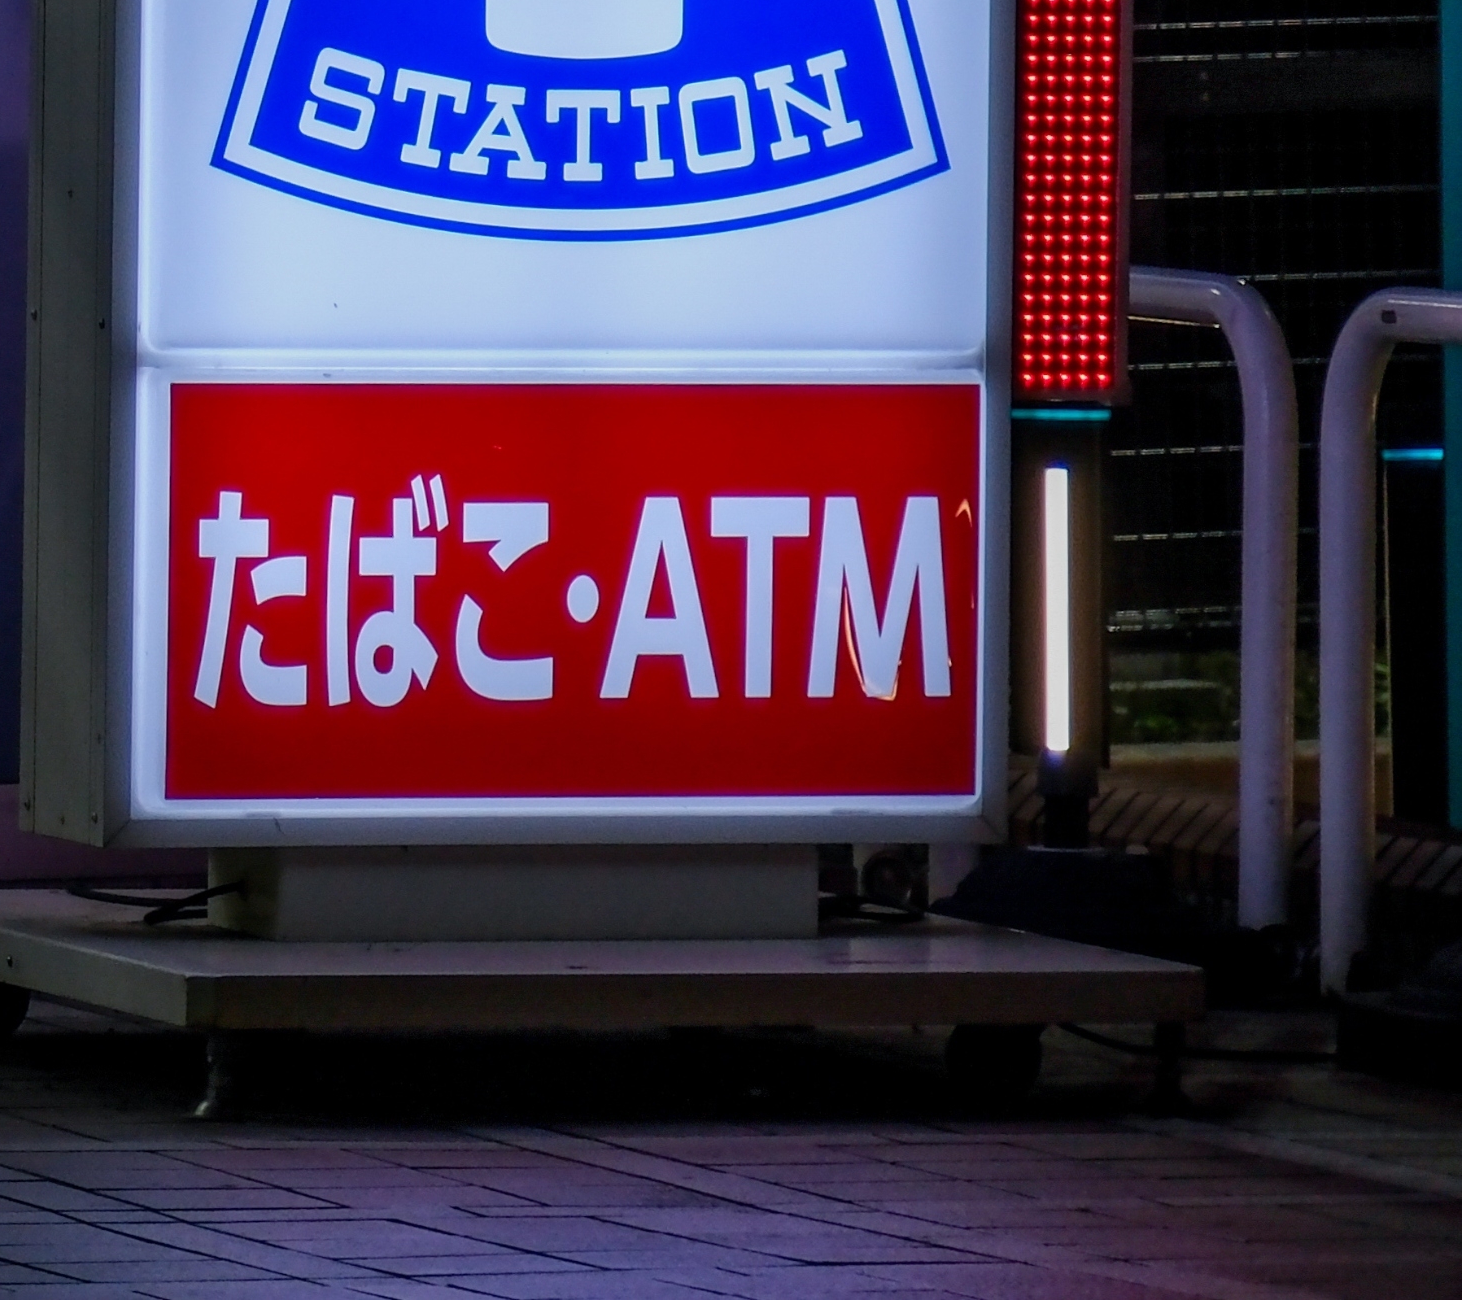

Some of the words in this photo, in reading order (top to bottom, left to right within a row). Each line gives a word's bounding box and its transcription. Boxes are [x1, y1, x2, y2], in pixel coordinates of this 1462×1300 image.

[298, 46, 862, 182] STATION
[192, 473, 954, 708] たばこ・ATM
